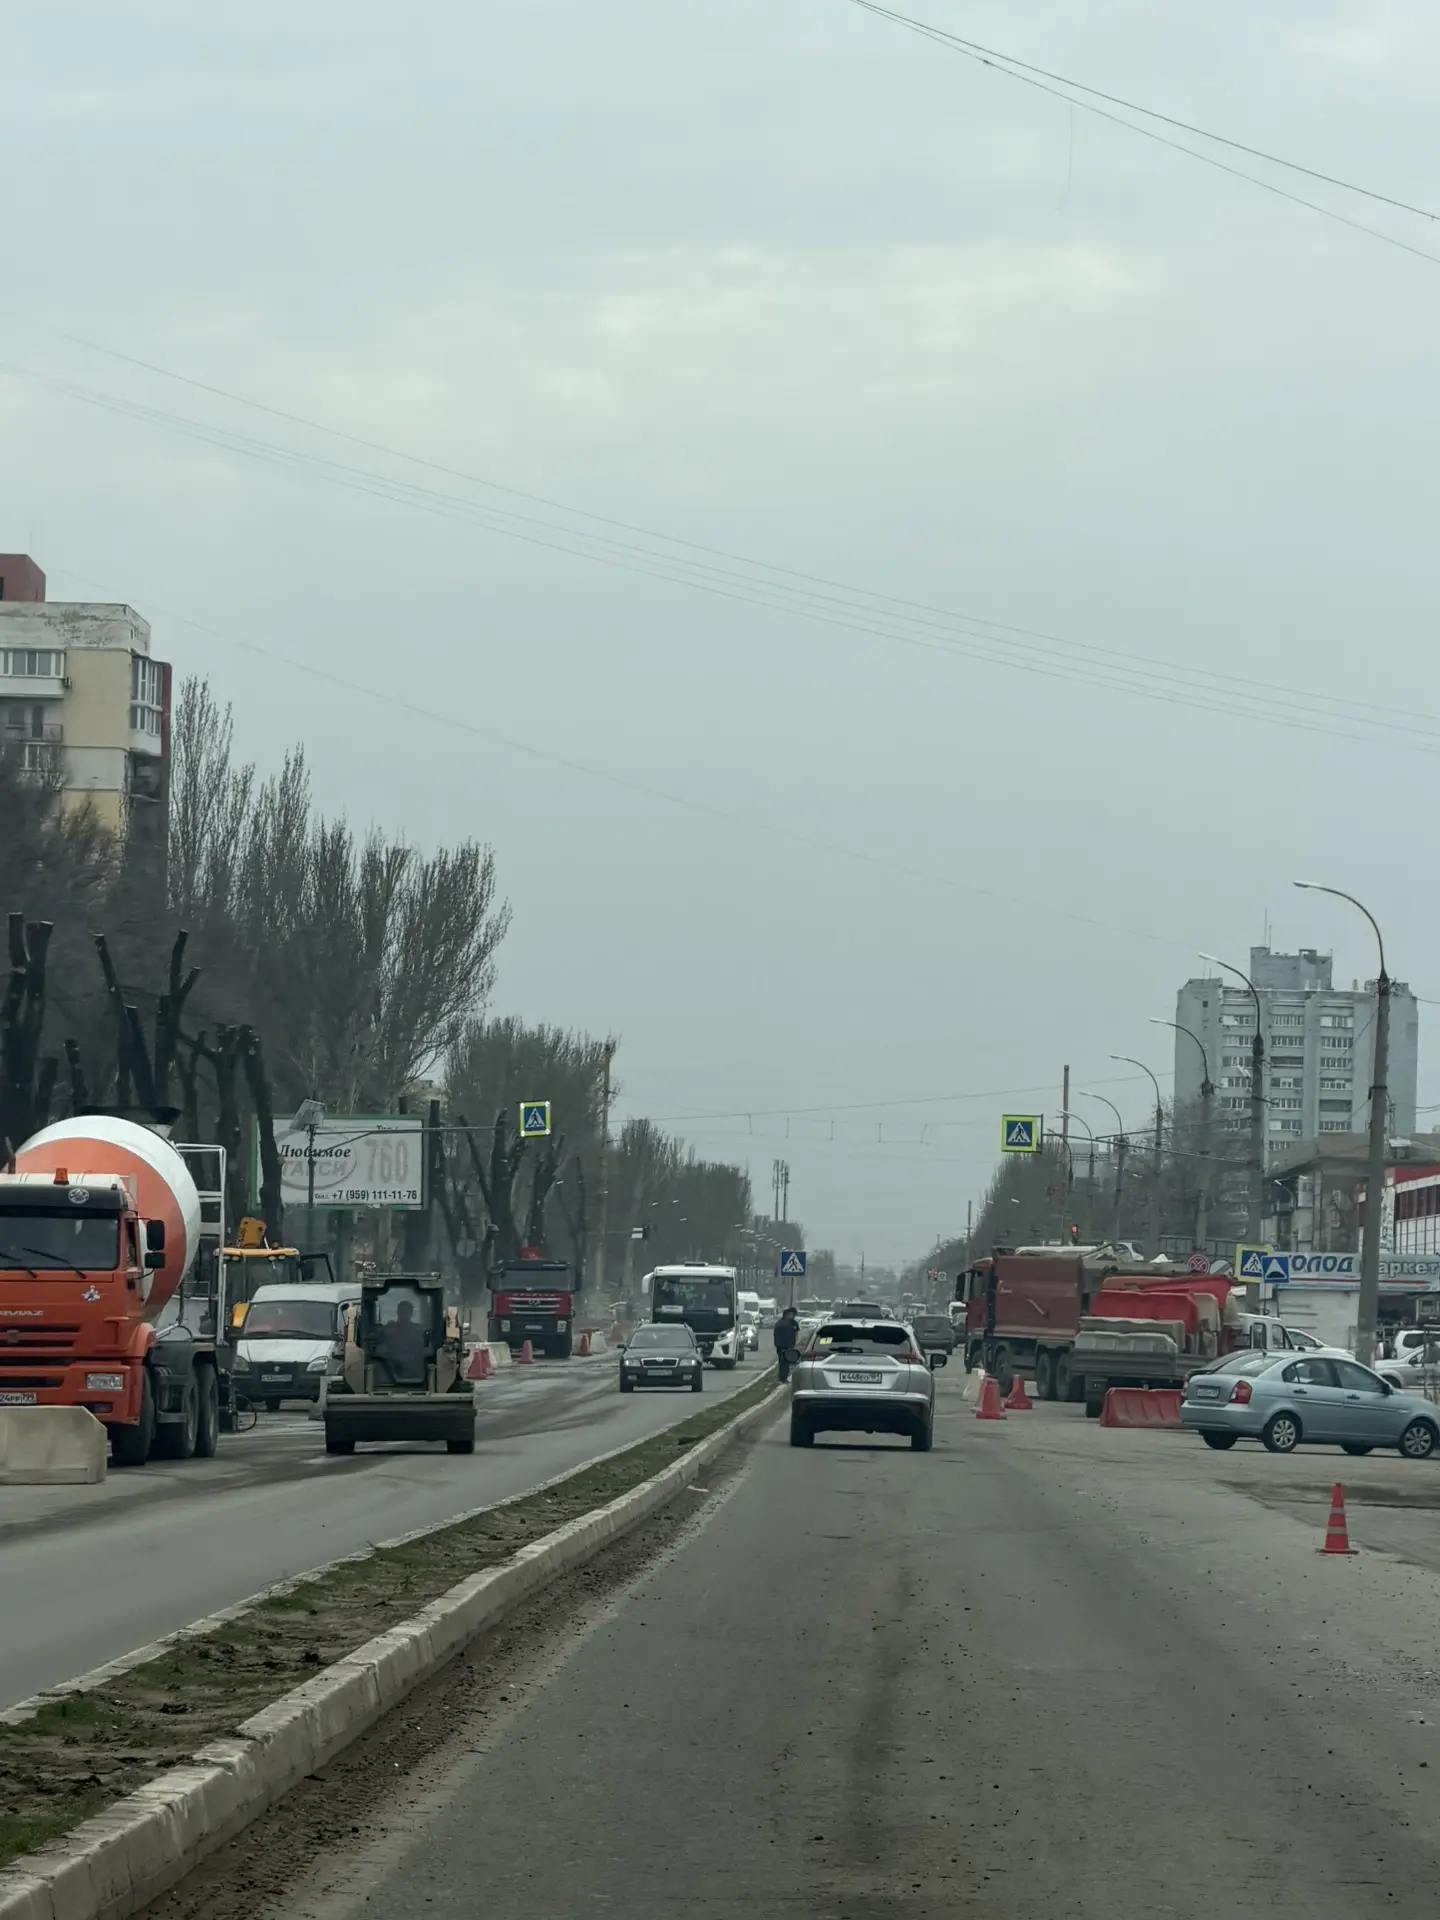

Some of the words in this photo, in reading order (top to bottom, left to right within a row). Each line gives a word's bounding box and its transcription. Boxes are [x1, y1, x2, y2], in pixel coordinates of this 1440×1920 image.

[280, 1144, 351, 1158] Любимое
[365, 1139, 408, 1184] 760
[332, 1190, 343, 1200] +7
[345, 1190, 369, 1201] (959)
[1289, 1254, 1354, 1273] ОЛОД
[1378, 1261, 1439, 1278] аркет
